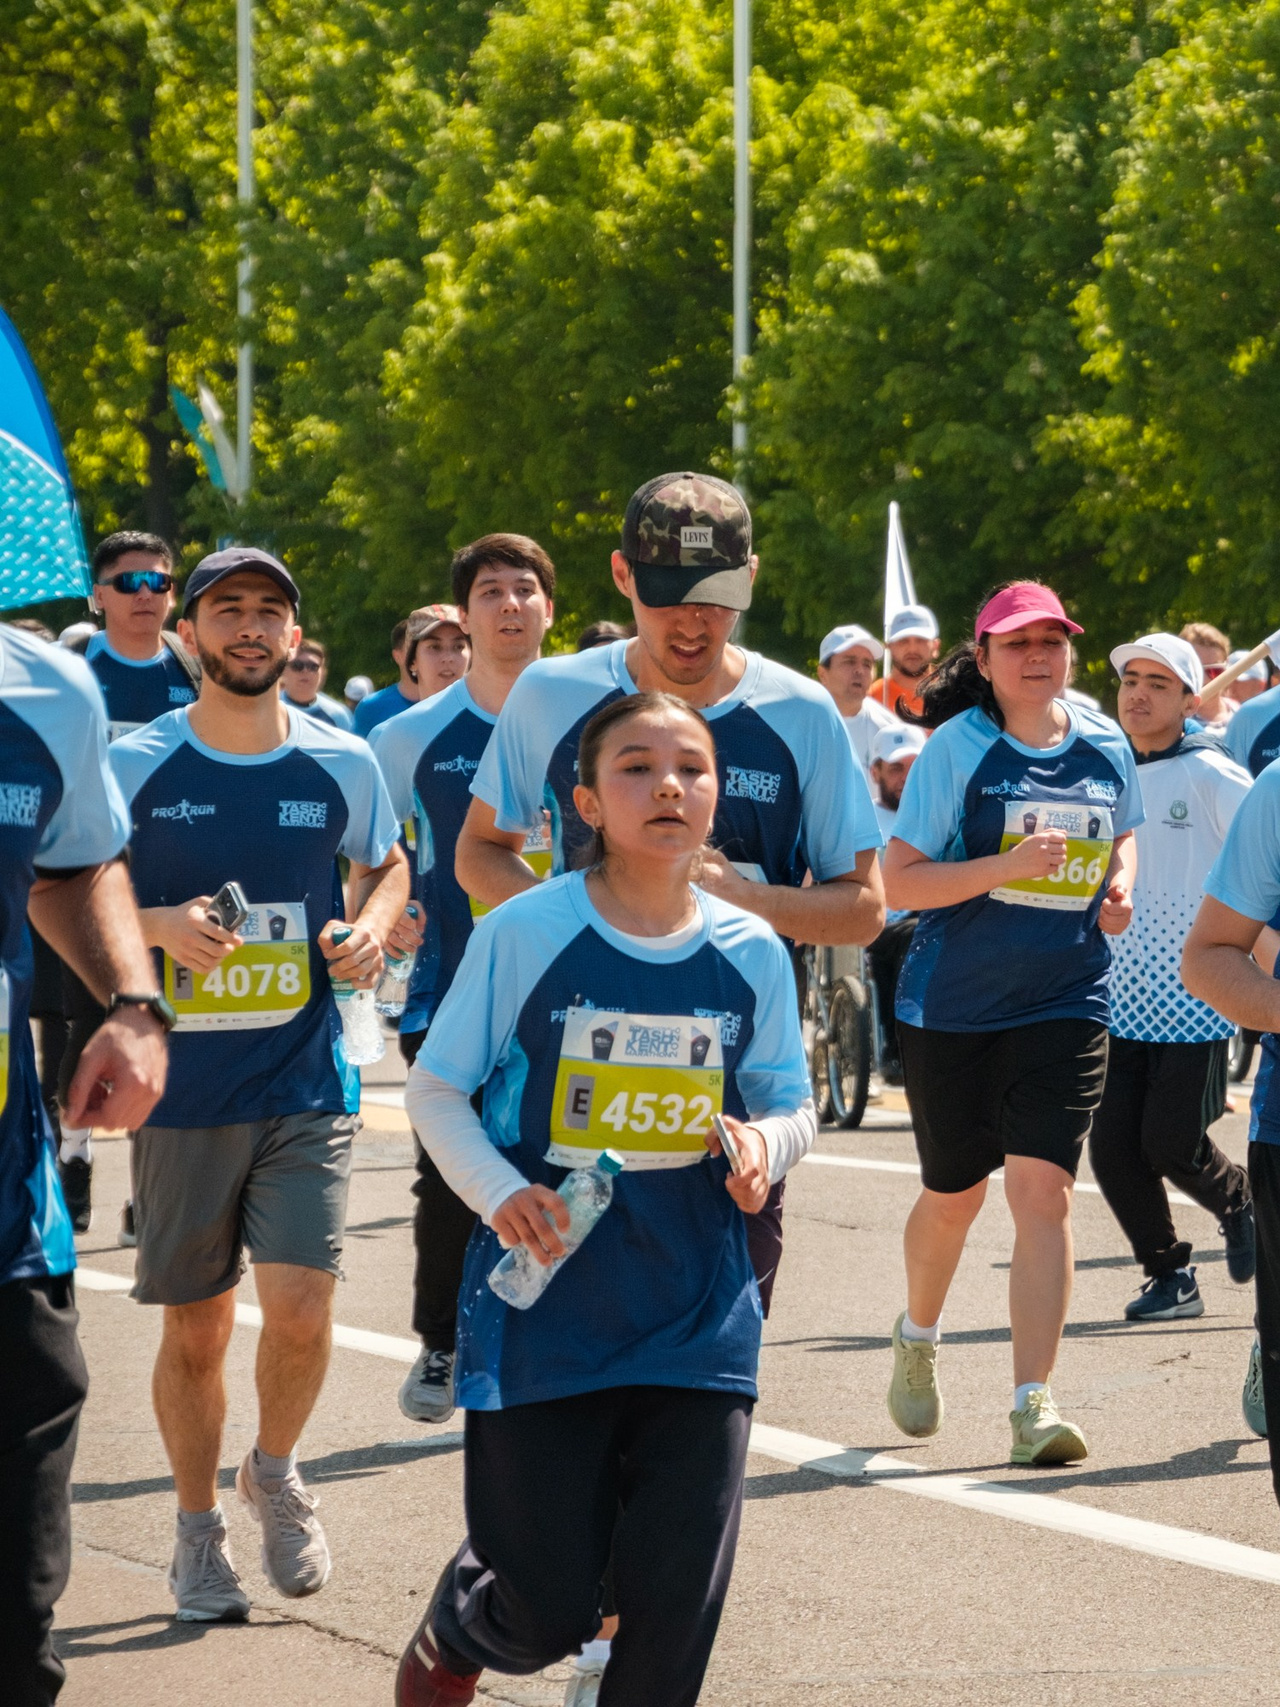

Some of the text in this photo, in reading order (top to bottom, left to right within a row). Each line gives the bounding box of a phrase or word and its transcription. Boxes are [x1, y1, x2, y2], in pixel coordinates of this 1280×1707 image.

[434, 760, 480, 771] PRO RU
[727, 769, 774, 789] TASH
[0, 786, 34, 805] ASH
[725, 779, 768, 799] KENT
[981, 786, 1001, 796] PRO
[152, 805, 216, 818] PRO RUN
[279, 803, 320, 814] TASH
[279, 812, 318, 823] KENT
[1100, 844, 1111, 853] 5K
[290, 945, 306, 955] 5K
[175, 967, 188, 989] F
[201, 962, 301, 998] 4078
[550, 1010, 567, 1023] PR
[628, 1027, 674, 1044] TASH
[625, 1039, 671, 1054] KENT
[708, 1073, 721, 1086] 5K
[571, 1088, 590, 1116] E
[601, 1092, 713, 1135] 4532
